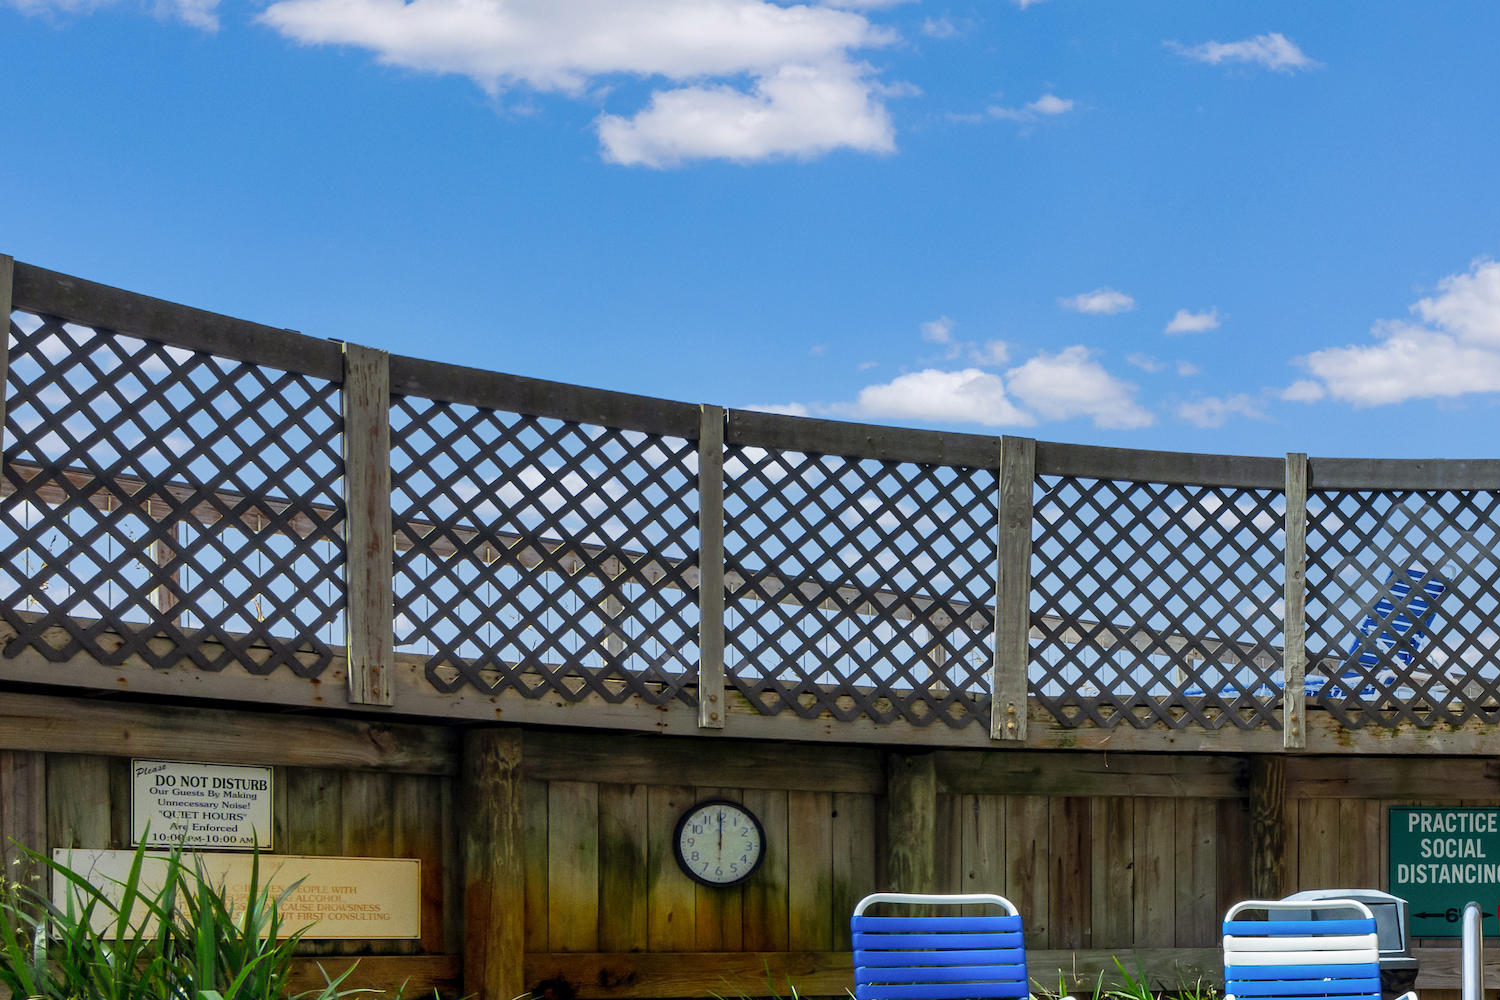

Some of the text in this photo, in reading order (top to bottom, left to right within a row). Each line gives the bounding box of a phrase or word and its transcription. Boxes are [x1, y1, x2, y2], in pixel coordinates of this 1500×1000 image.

[135, 764, 167, 778] Please
[155, 774, 268, 791] DO NOT DISTURB
[149, 787, 257, 801] Our Guests By Making
[157, 799, 250, 810] Unnecessary Noise!
[169, 822, 238, 832] Are Enforced
[1408, 813, 1498, 833] PRACTICE
[692, 824, 703, 834] 10
[740, 827, 749, 837] 2
[687, 837, 695, 847] 9
[745, 841, 753, 851] 3
[1420, 838, 1486, 858] SOCIAL
[691, 851, 699, 861] 8
[740, 854, 747, 864] 4
[703, 861, 710, 871] 7
[715, 866, 723, 876] 6
[730, 863, 738, 873] 5
[331, 886, 358, 894] WITH
[280, 903, 315, 912] CAUSE
[317, 904, 382, 912] DROWSINESS
[327, 913, 392, 921] CONSULTING
